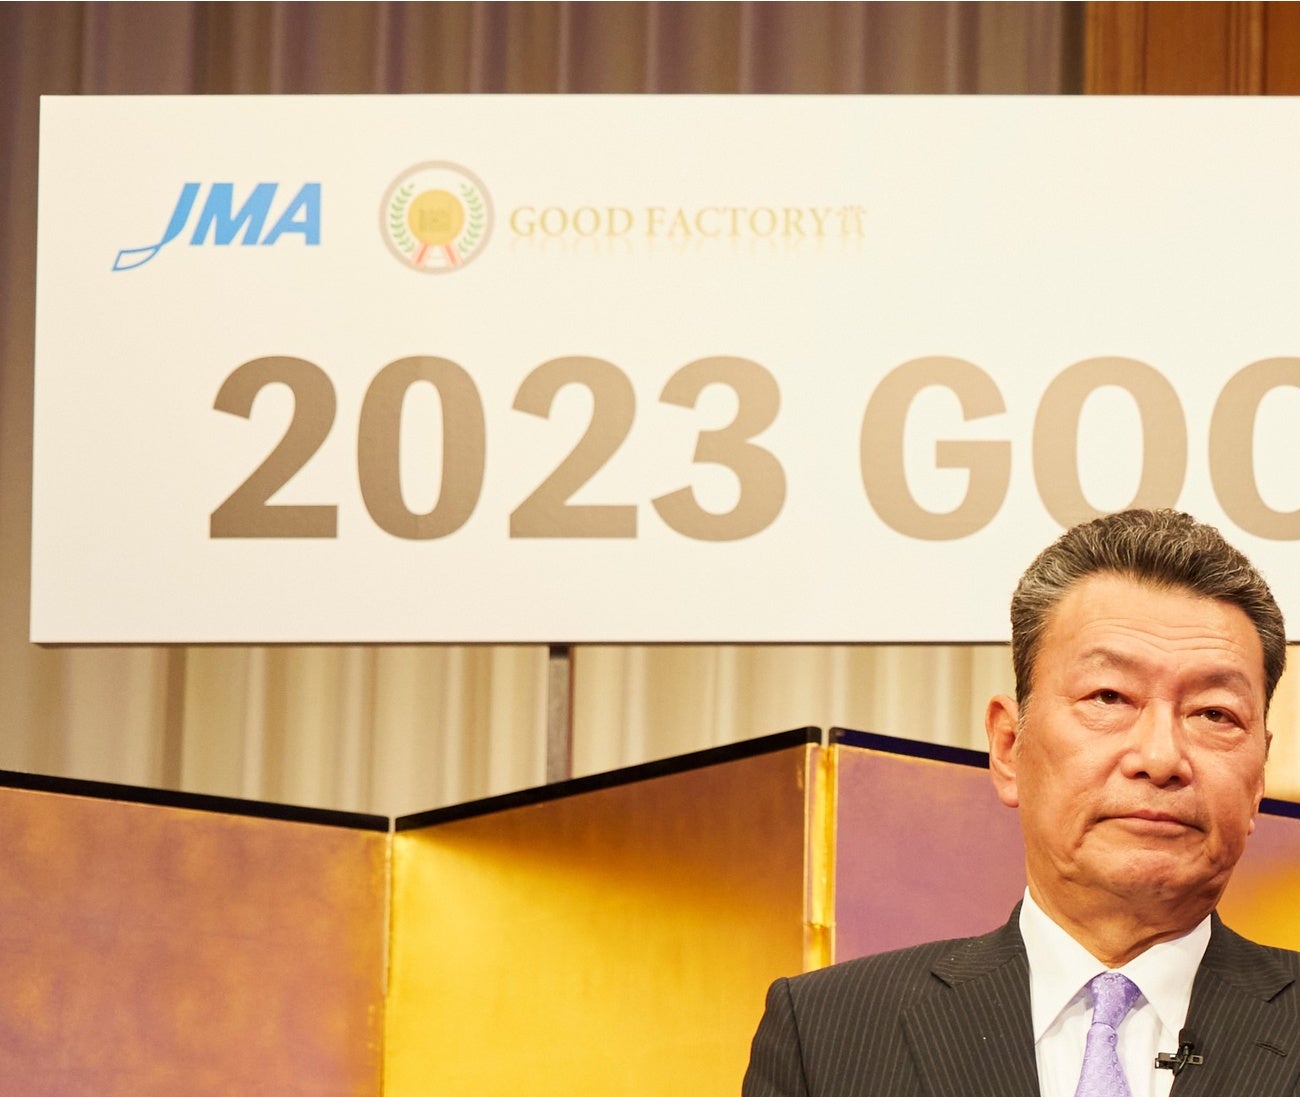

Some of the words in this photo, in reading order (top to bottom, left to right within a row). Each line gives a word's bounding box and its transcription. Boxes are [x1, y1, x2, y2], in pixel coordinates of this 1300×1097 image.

[112, 182, 322, 272] JMA
[509, 206, 634, 237] GOOD
[209, 354, 788, 543] 2023
